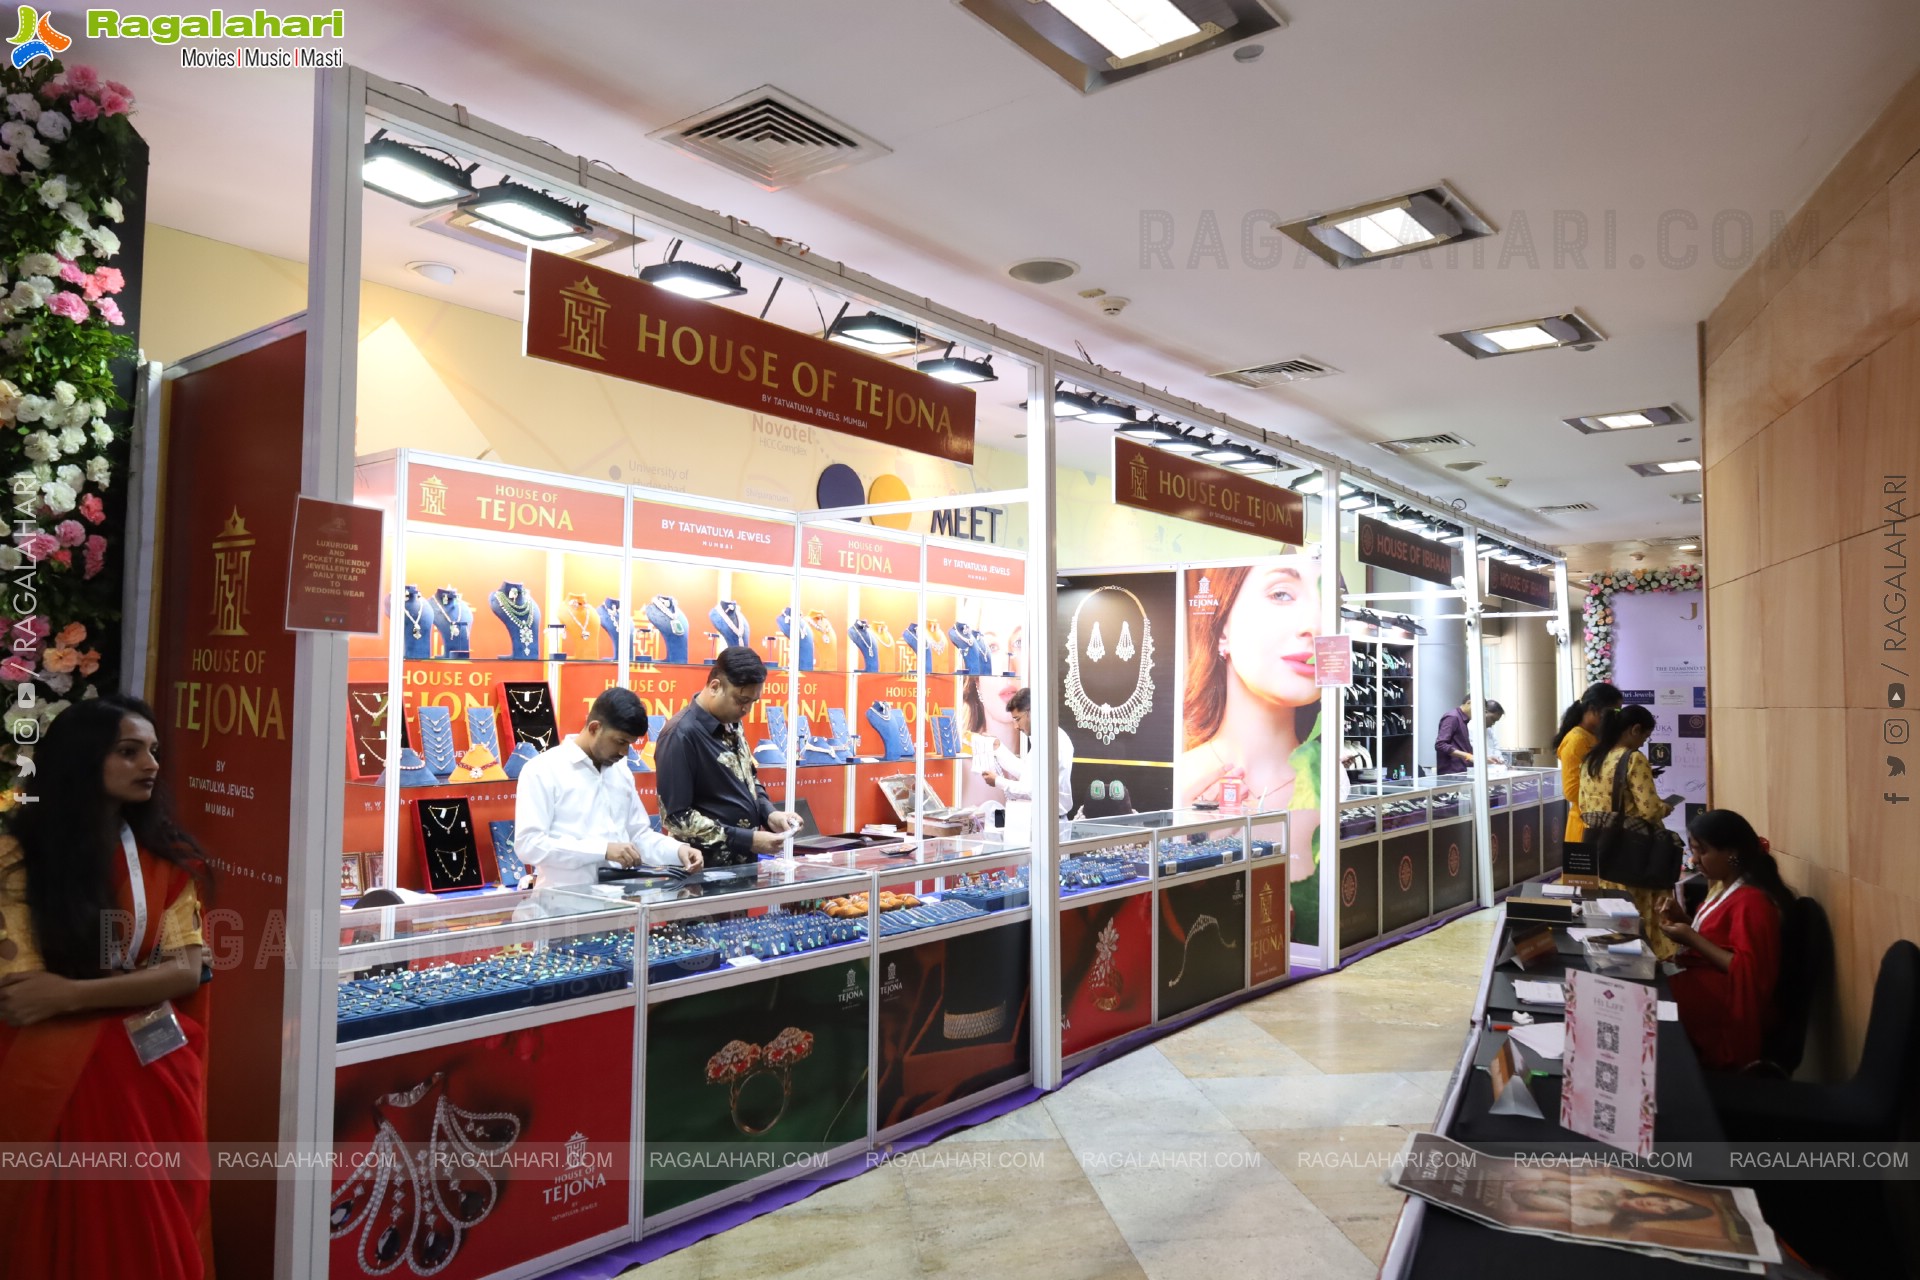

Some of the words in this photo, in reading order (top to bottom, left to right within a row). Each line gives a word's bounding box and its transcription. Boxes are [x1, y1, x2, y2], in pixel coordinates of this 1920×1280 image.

[637, 313, 779, 389] HOUSE
[792, 361, 836, 402] OF
[852, 377, 952, 435] TEJONA
[762, 393, 773, 403] BY
[774, 396, 814, 415] TATVATULYA
[843, 415, 868, 429] MUMBAI
[752, 413, 814, 444] Novotel
[628, 460, 678, 480] University
[679, 469, 689, 479] of
[495, 484, 539, 501] HOUSE
[542, 491, 558, 504] OF
[1159, 470, 1217, 507] HOUSE
[1221, 488, 1240, 513] OF
[1247, 495, 1294, 529] TEJONA
[476, 496, 574, 531] TEJONA
[661, 519, 676, 530] BY
[678, 521, 735, 539] TATVATULYA
[736, 530, 771, 544] JEWELS
[930, 506, 1003, 543] MEET
[316, 540, 359, 551] LUXURIOUS
[329, 549, 345, 557] AND
[702, 540, 734, 550] MUMBAI
[848, 539, 873, 552] HOUSE
[874, 543, 884, 553] OF
[1377, 534, 1407, 561] HOUSE
[1409, 545, 1421, 564] OF
[303, 554, 334, 564] POCKET
[335, 557, 371, 568] FRIENDLY
[305, 563, 351, 573] JEWELLERY
[351, 567, 366, 575] FOR
[838, 549, 892, 575] TEJONA
[943, 557, 952, 567] BY
[953, 559, 988, 573] TATVATULYA
[989, 565, 1011, 577] JEWELS
[313, 571, 335, 580] DAILY
[336, 573, 359, 582] WEAR
[331, 580, 341, 588] TO
[305, 586, 342, 596] WEDDING
[343, 589, 365, 598] WEAR
[1188, 599, 1219, 609] TEJONA
[192, 648, 240, 673] HOUSE
[244, 650, 266, 674] OF
[468, 671, 493, 687] OF
[658, 679, 677, 693] OF
[803, 683, 817, 695] OF
[173, 681, 286, 749] TEJONA
[216, 760, 226, 772] BY
[189, 776, 226, 794] TATVATULYA
[226, 783, 255, 800] JEWELS
[205, 802, 235, 818] MUMBAI
[838, 989, 864, 1003] TEJONA
[880, 982, 903, 995] TEJONA
[554, 1168, 583, 1184] HOUSE
[584, 1165, 596, 1175] OF
[542, 1172, 607, 1205] TEJONA
